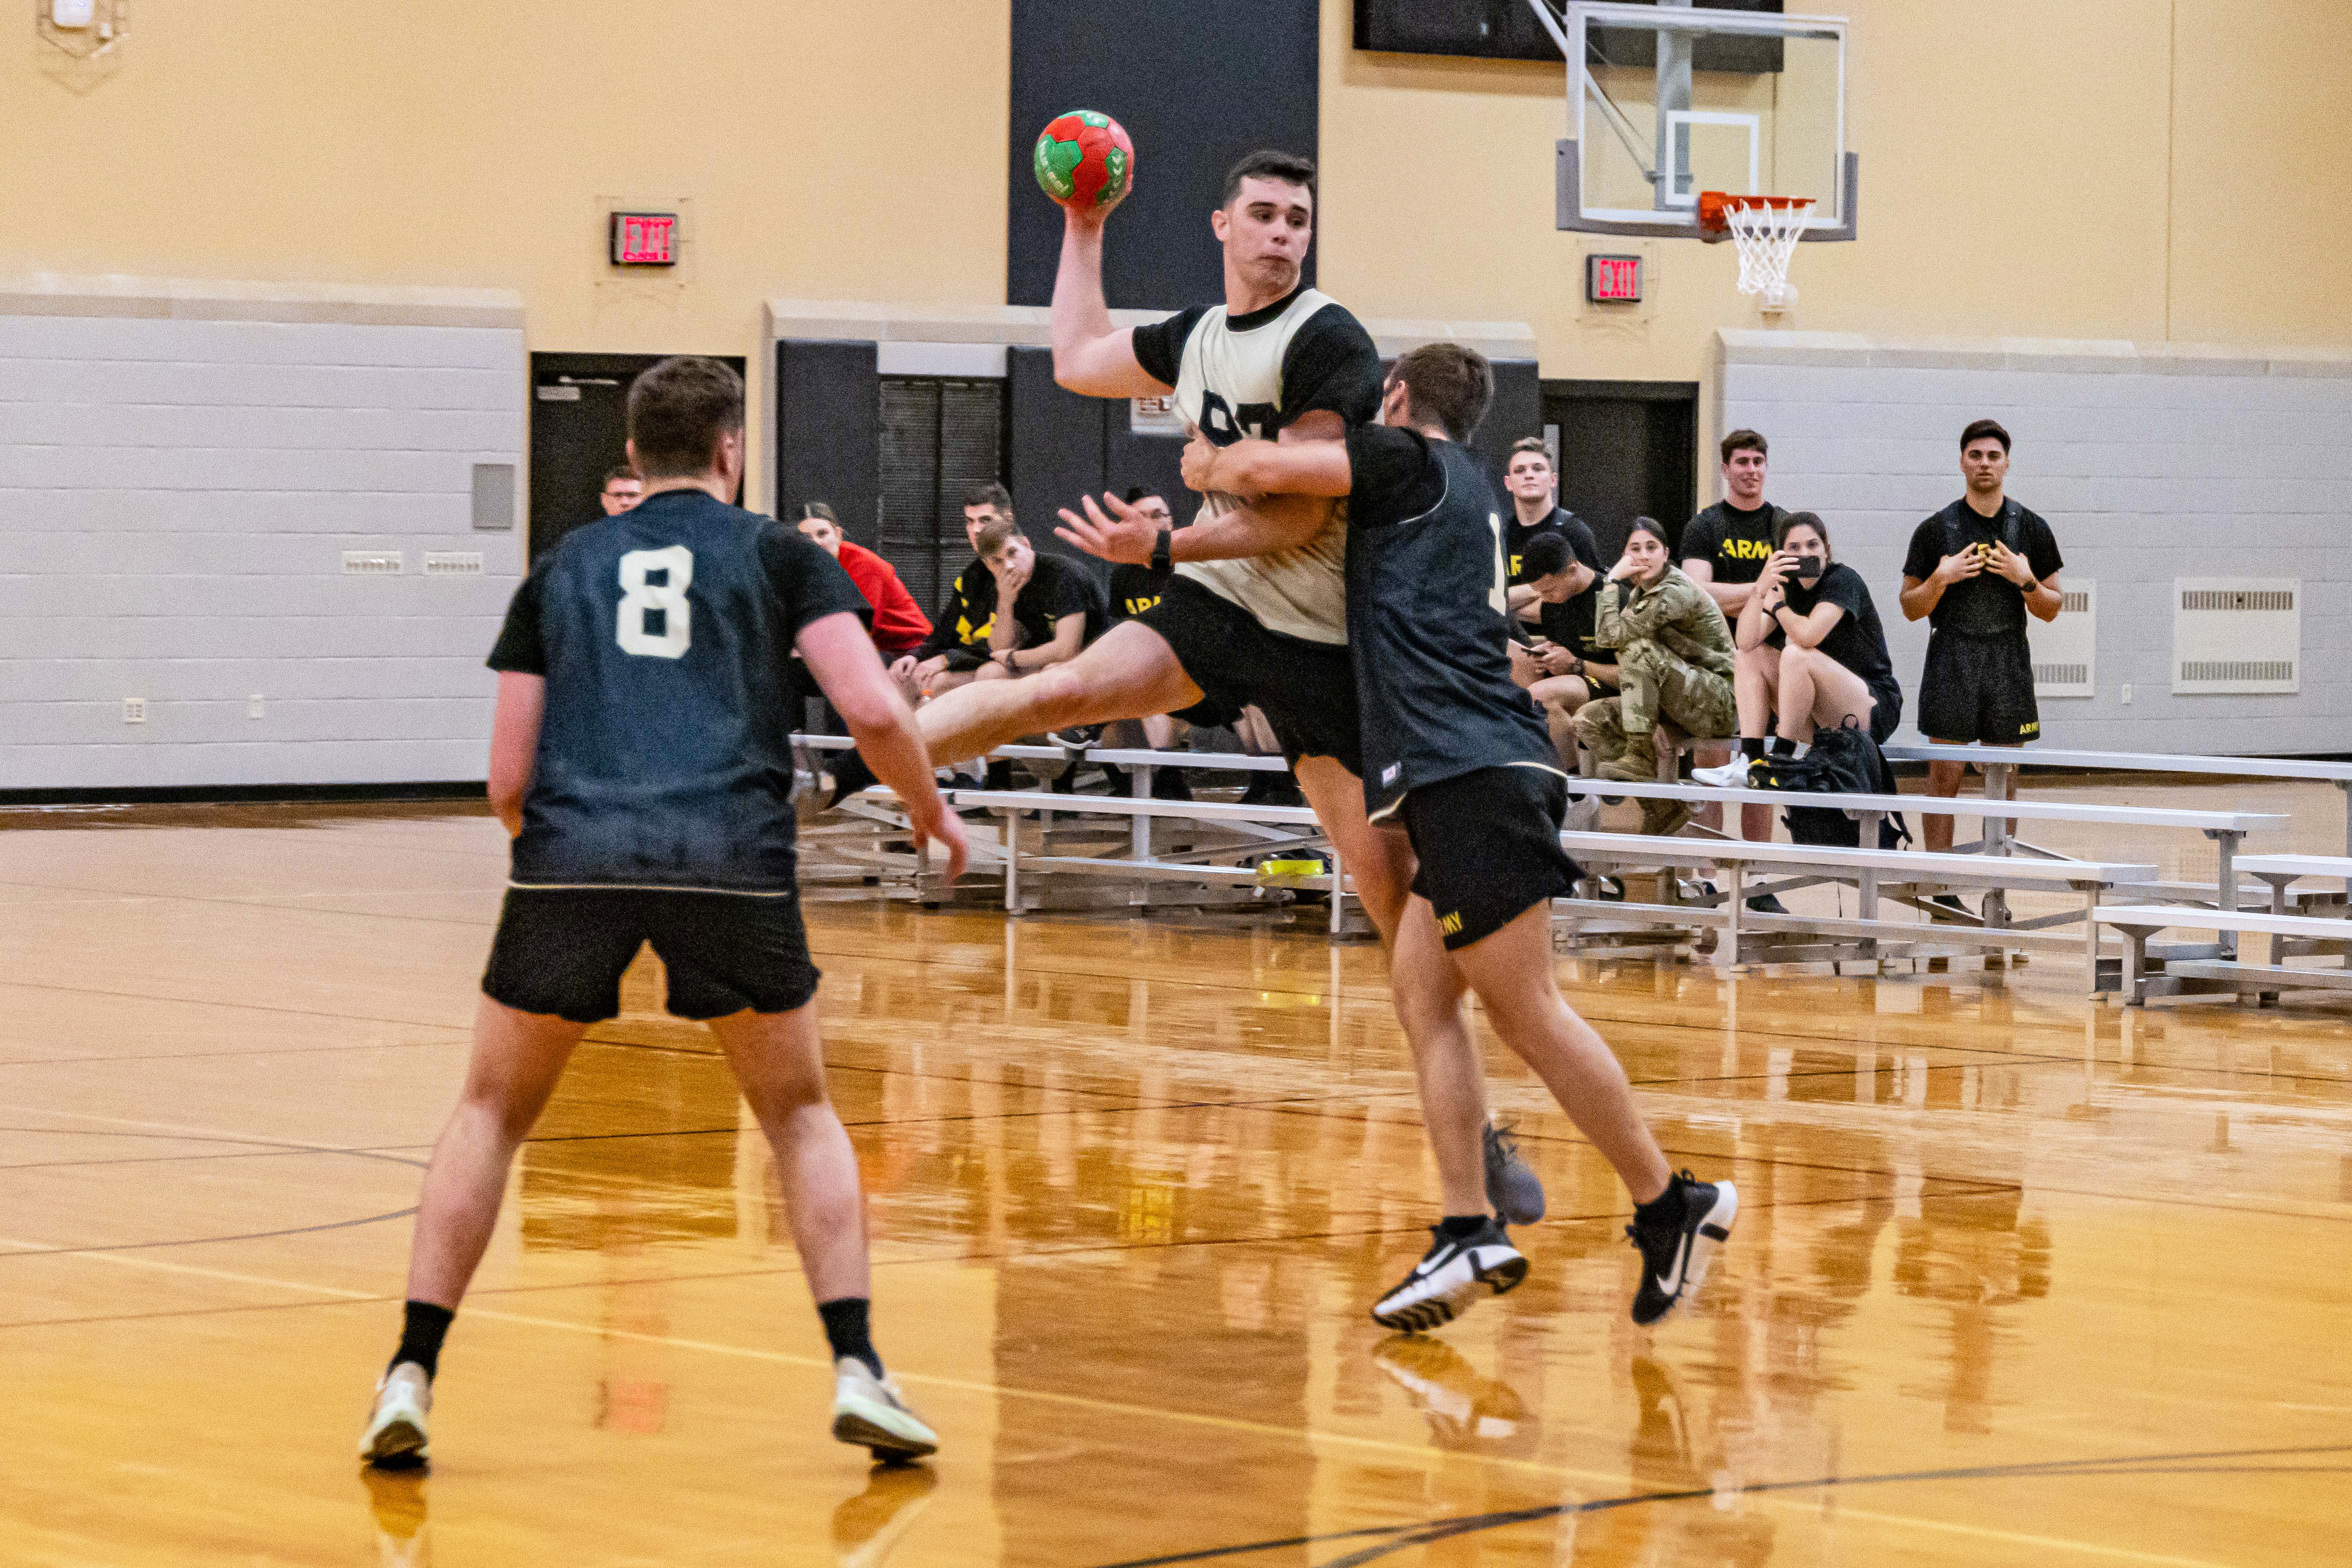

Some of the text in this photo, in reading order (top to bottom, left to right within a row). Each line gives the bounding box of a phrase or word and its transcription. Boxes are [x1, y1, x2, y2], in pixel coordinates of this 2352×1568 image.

[623, 217, 673, 261] EXIT
[1598, 259, 1637, 298] EXIT
[1718, 538, 1773, 560] ARM
[616, 545, 693, 659] 8
